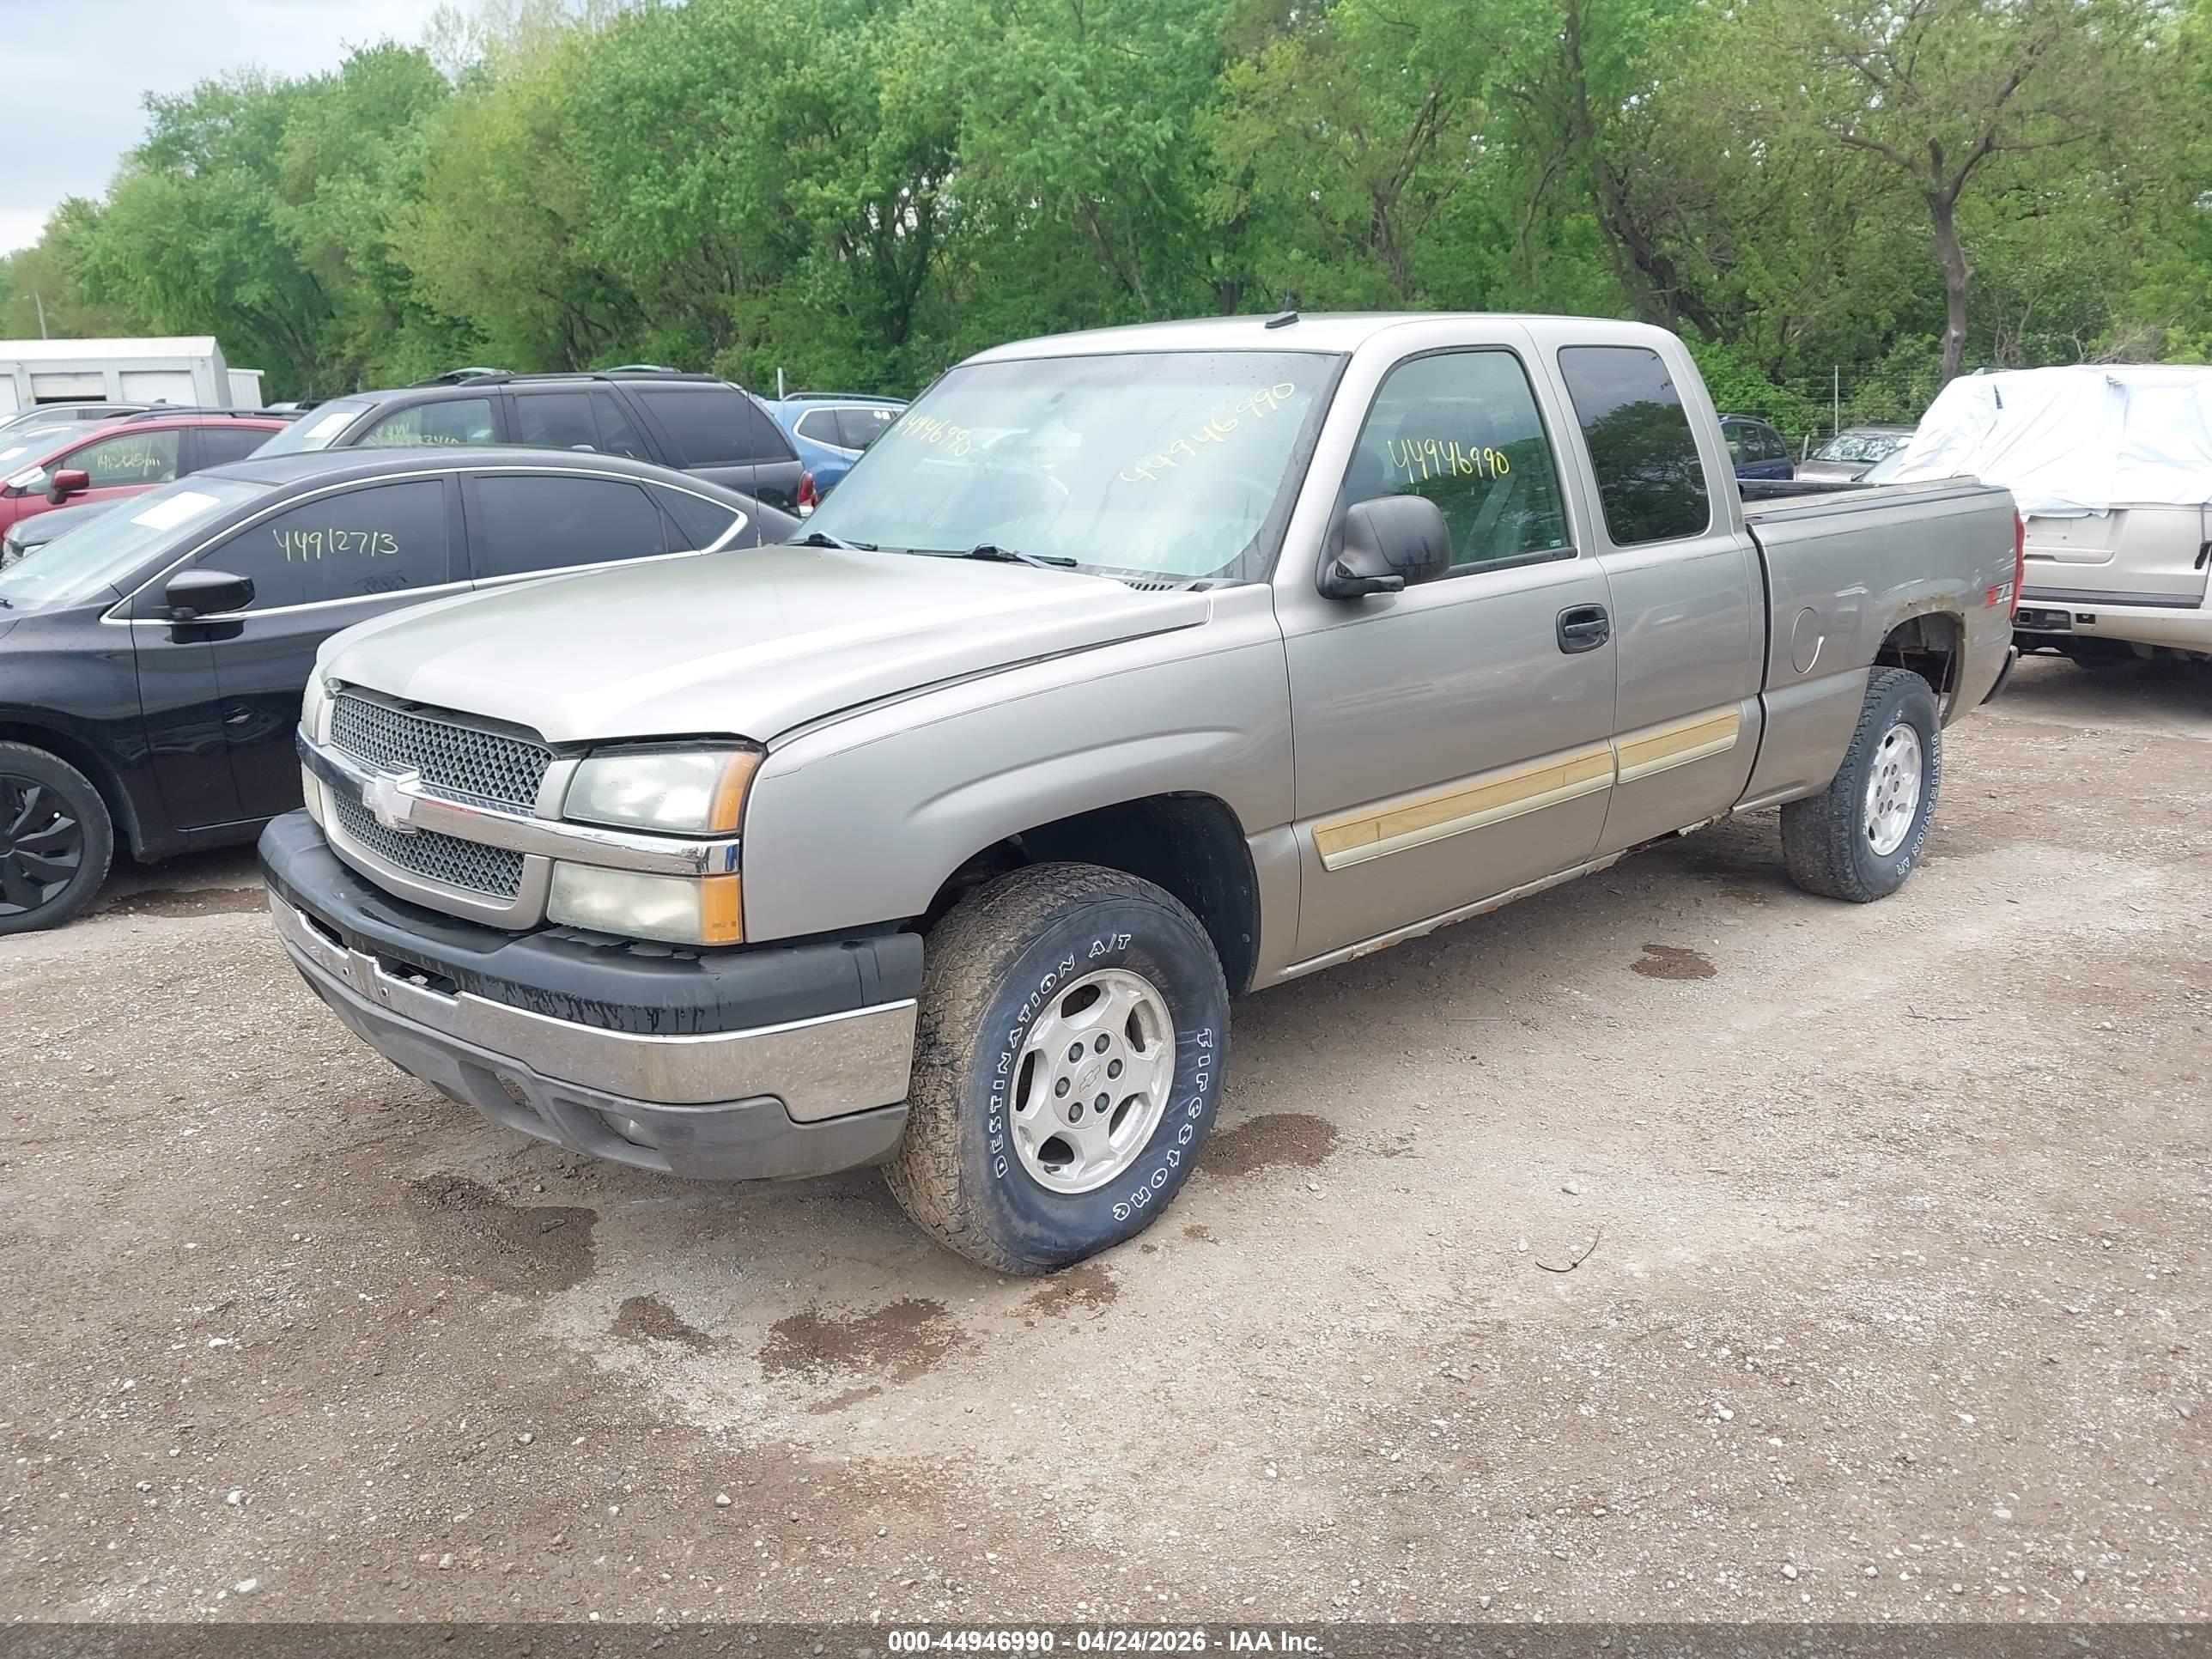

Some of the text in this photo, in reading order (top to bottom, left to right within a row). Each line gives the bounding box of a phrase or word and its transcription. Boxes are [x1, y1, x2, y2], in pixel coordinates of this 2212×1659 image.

[1119, 382, 1295, 482] 44946990
[1387, 438, 1510, 484] 44946990
[273, 528, 398, 562] 44912713
[1911, 732, 1940, 857] DESTINATION
[988, 933, 1132, 1179] DESTINATION A/T
